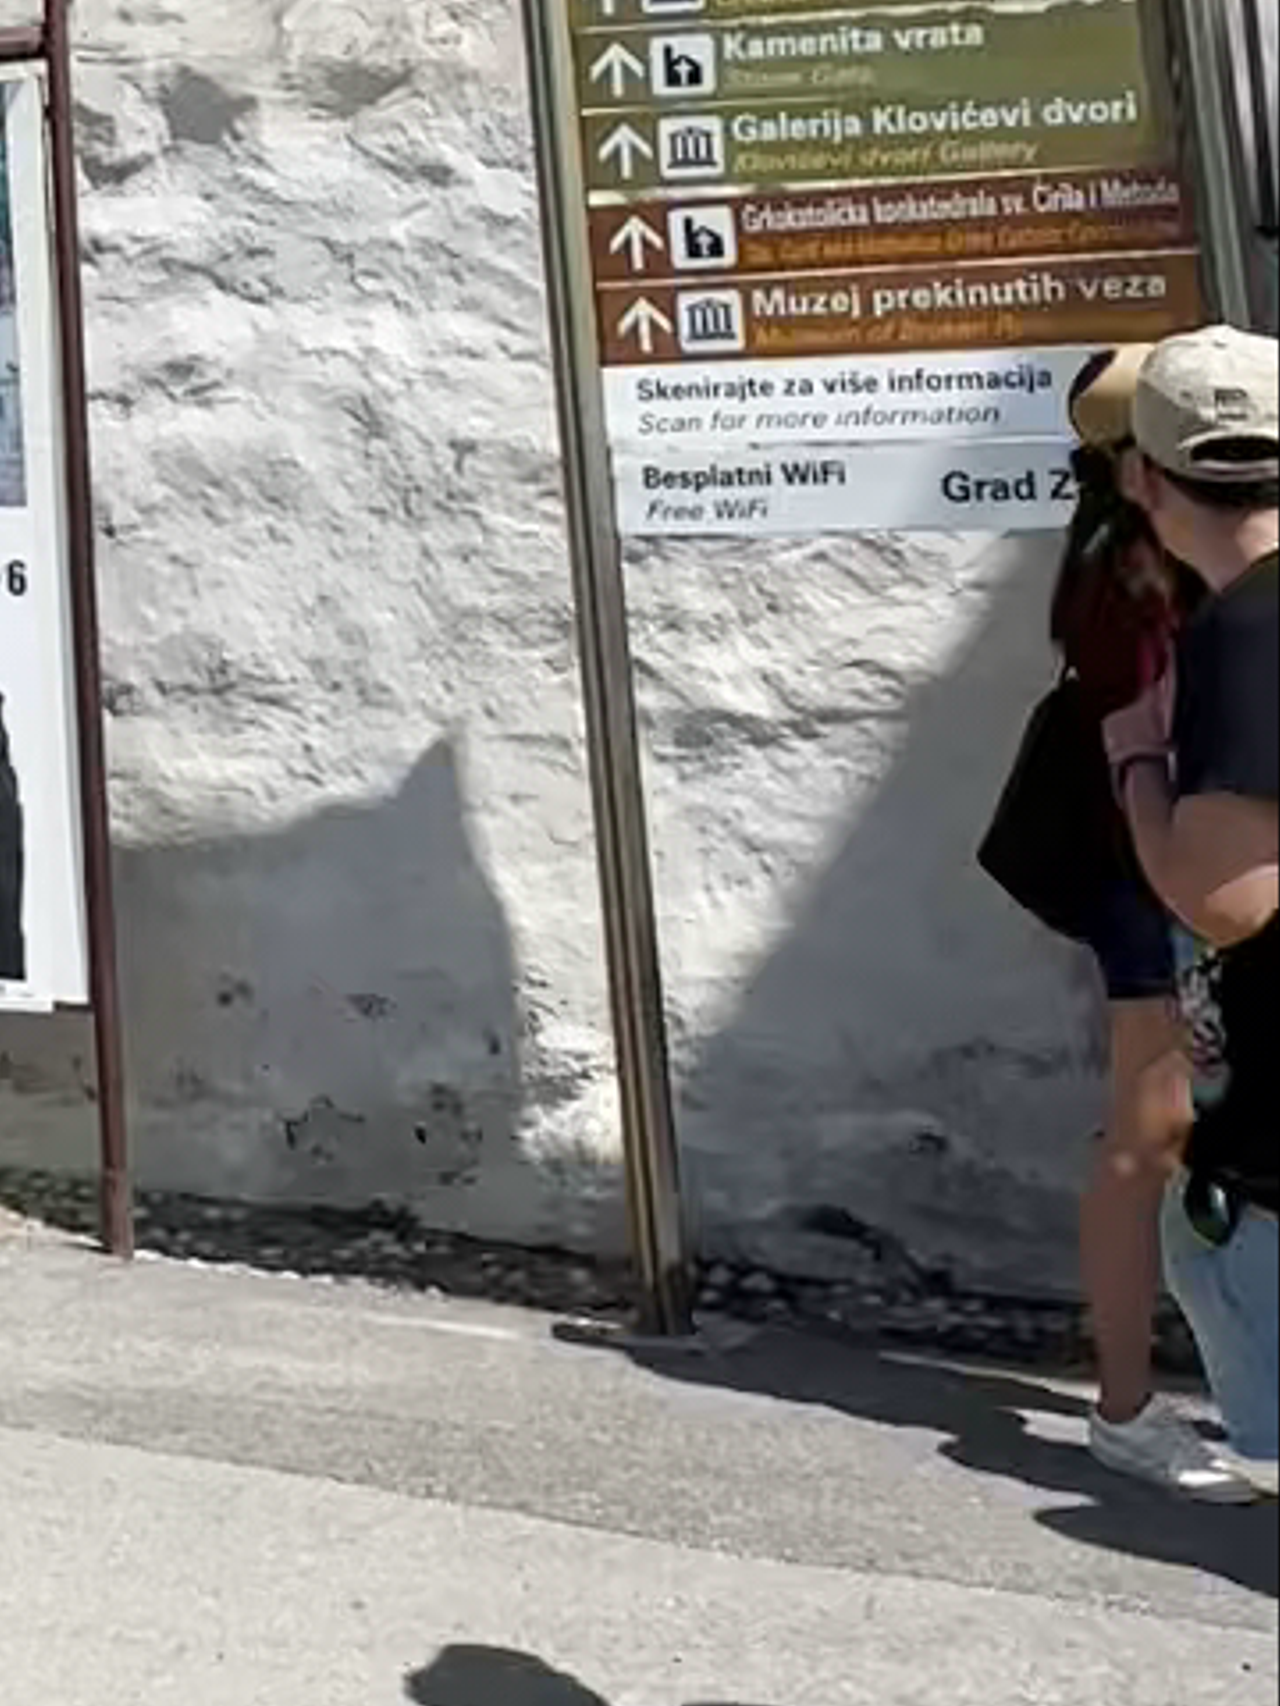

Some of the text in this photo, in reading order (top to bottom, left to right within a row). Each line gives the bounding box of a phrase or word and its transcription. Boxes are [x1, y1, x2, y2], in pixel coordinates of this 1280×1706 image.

[724, 22, 985, 61] Kamenita vrata
[732, 89, 1137, 144] Galerija Klovićevi dvori
[750, 272, 1167, 319] Muzej prekinutih veza
[636, 364, 1054, 405] Skenirajte za više informacija
[637, 403, 1001, 436] Scan for more information
[642, 458, 847, 493] Besplatni WiFi
[941, 469, 1038, 504] Grad
[645, 497, 769, 522] Free WiFi
